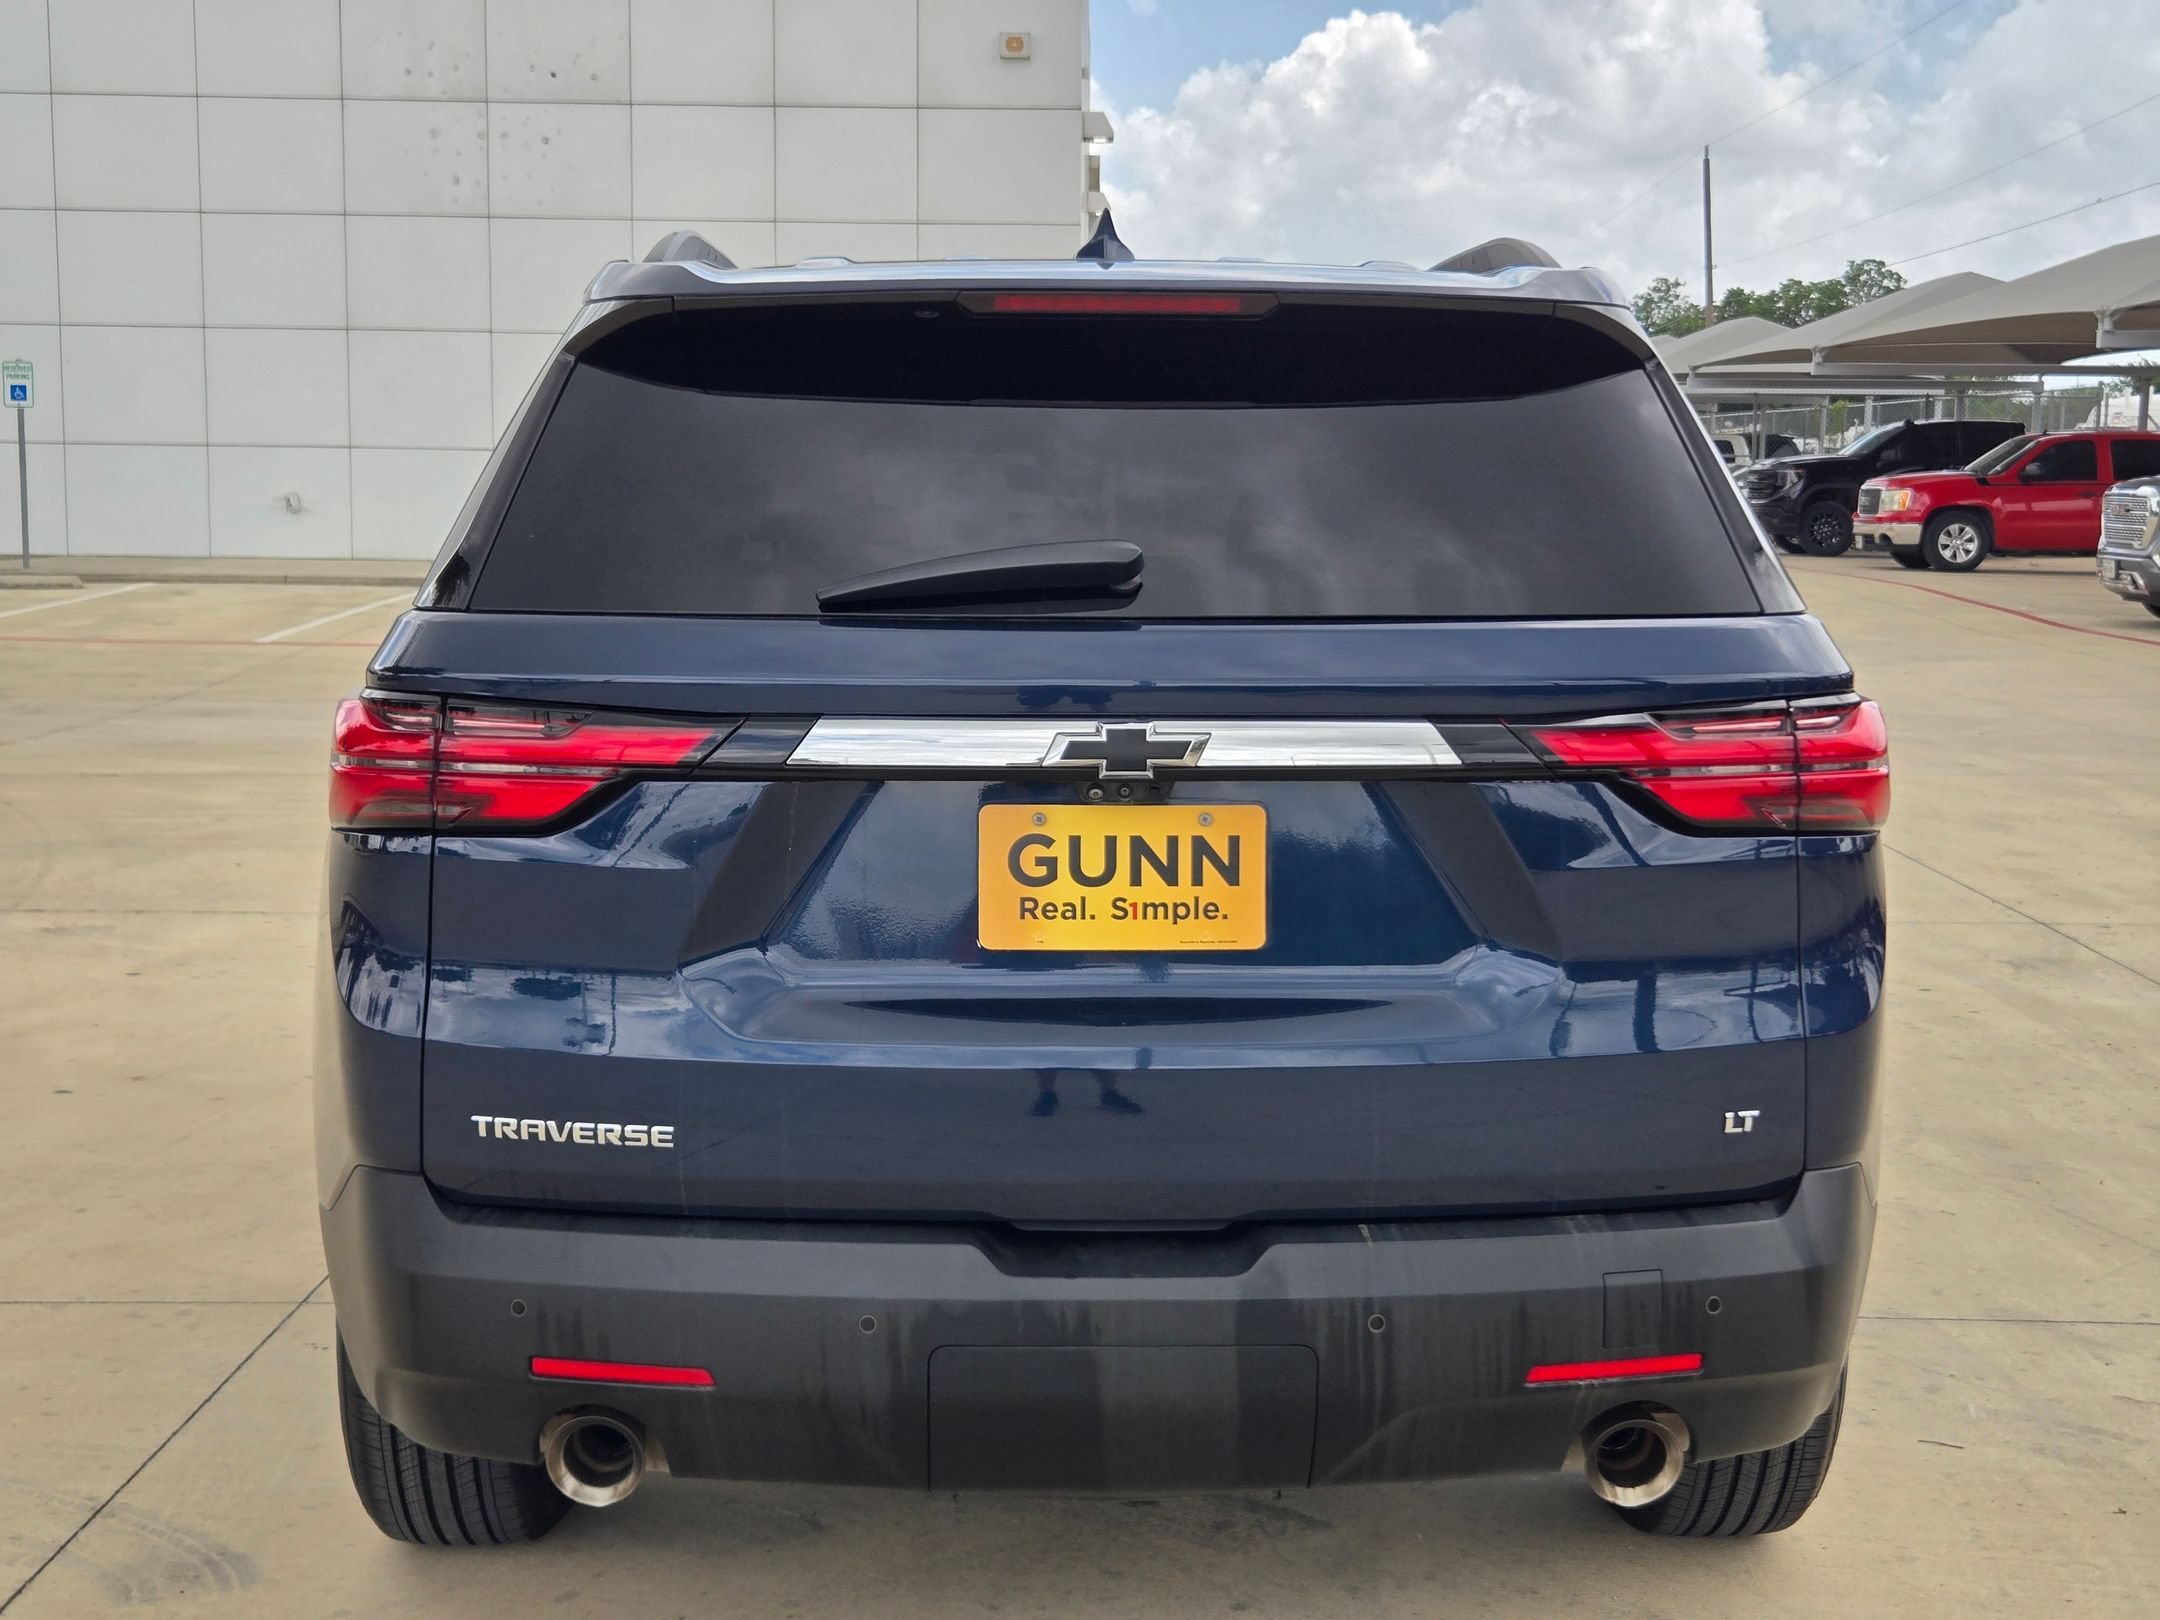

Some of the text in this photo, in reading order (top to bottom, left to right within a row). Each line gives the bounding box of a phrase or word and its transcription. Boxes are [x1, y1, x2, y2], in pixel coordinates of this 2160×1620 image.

[1007, 833, 1241, 888] GUNN
[1019, 896, 1096, 921] Real.
[470, 1115, 675, 1148] TRAVERSE
[1724, 1110, 1761, 1134] LT
